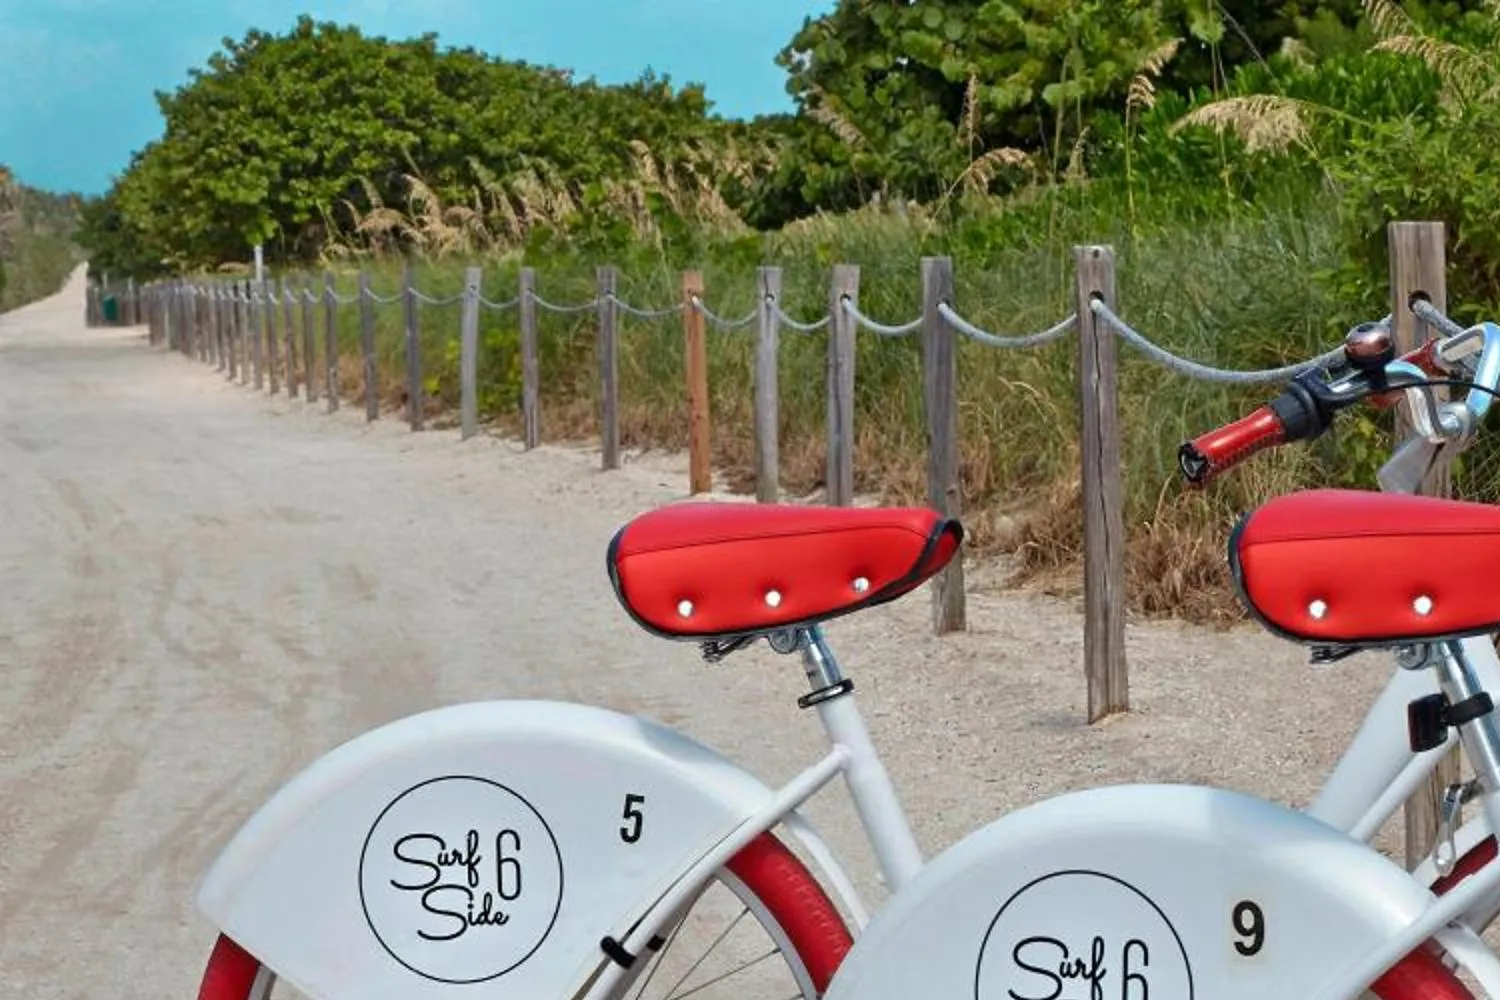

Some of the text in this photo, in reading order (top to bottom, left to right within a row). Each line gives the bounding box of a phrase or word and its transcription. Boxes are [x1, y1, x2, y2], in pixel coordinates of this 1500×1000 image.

[619, 793, 646, 844] 5
[389, 829, 481, 891] Surf
[495, 827, 522, 901] 6
[416, 883, 511, 941] Side
[1231, 899, 1266, 958] 9
